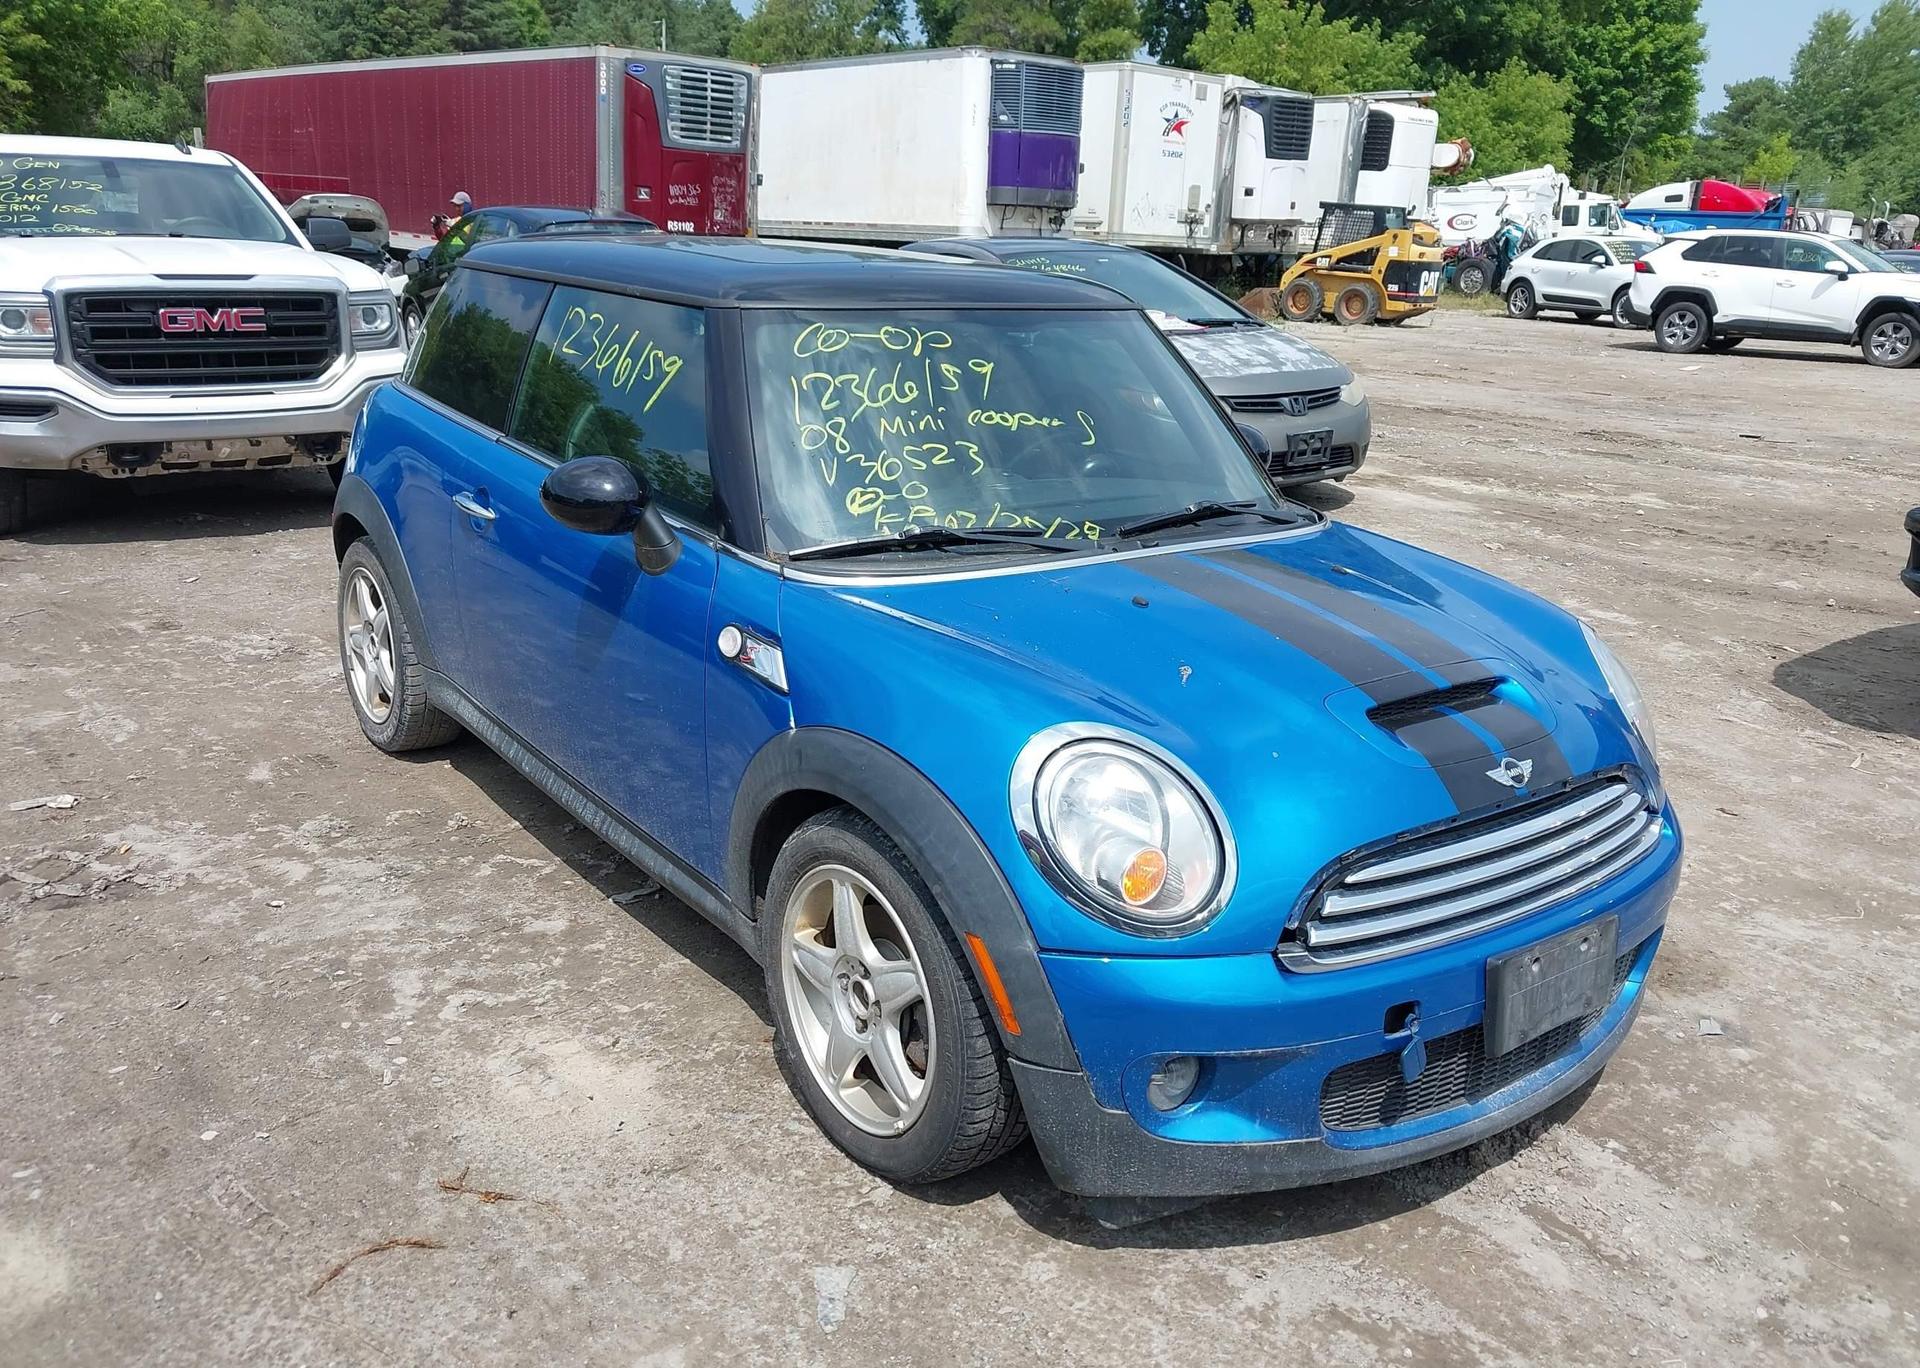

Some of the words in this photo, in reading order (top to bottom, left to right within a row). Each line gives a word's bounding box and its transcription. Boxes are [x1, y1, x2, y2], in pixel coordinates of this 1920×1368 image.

[667, 220, 695, 233] R51102
[1317, 257, 1330, 267] CAT
[1419, 270, 1440, 297] CAT
[159, 307, 266, 332] GMC
